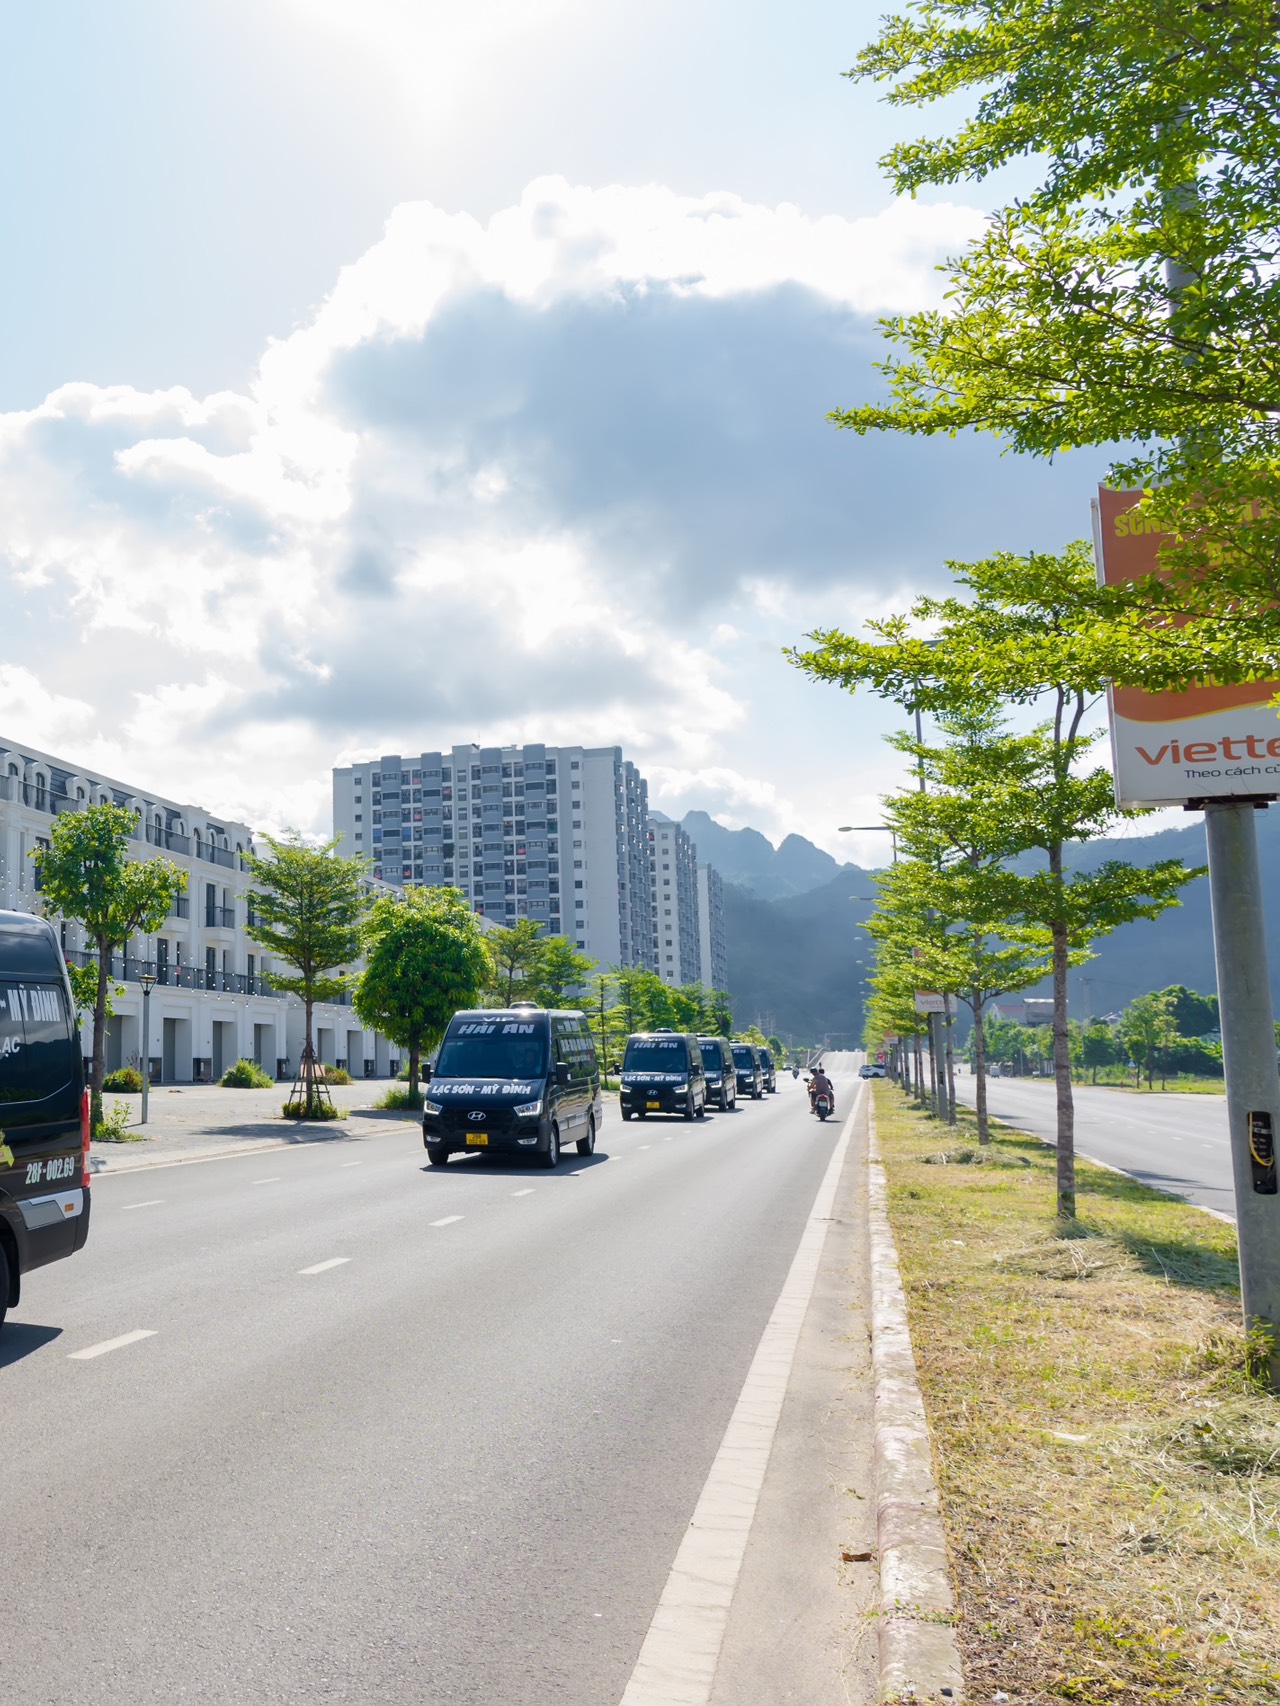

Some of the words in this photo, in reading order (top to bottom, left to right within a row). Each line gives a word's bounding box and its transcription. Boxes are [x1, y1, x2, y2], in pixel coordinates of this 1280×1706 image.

[1184, 769, 1221, 779] Theo
[1225, 765, 1261, 777] cách
[7, 983, 29, 1022] MỸ
[30, 985, 61, 1022] ĐÌNH
[502, 1023, 535, 1034] AN
[431, 1085, 452, 1096] LẠC
[451, 1083, 475, 1094] SƠN
[480, 1083, 500, 1095] MỸ
[502, 1083, 531, 1095] ĐÌNH
[25, 1156, 75, 1185] 28F-002.69
